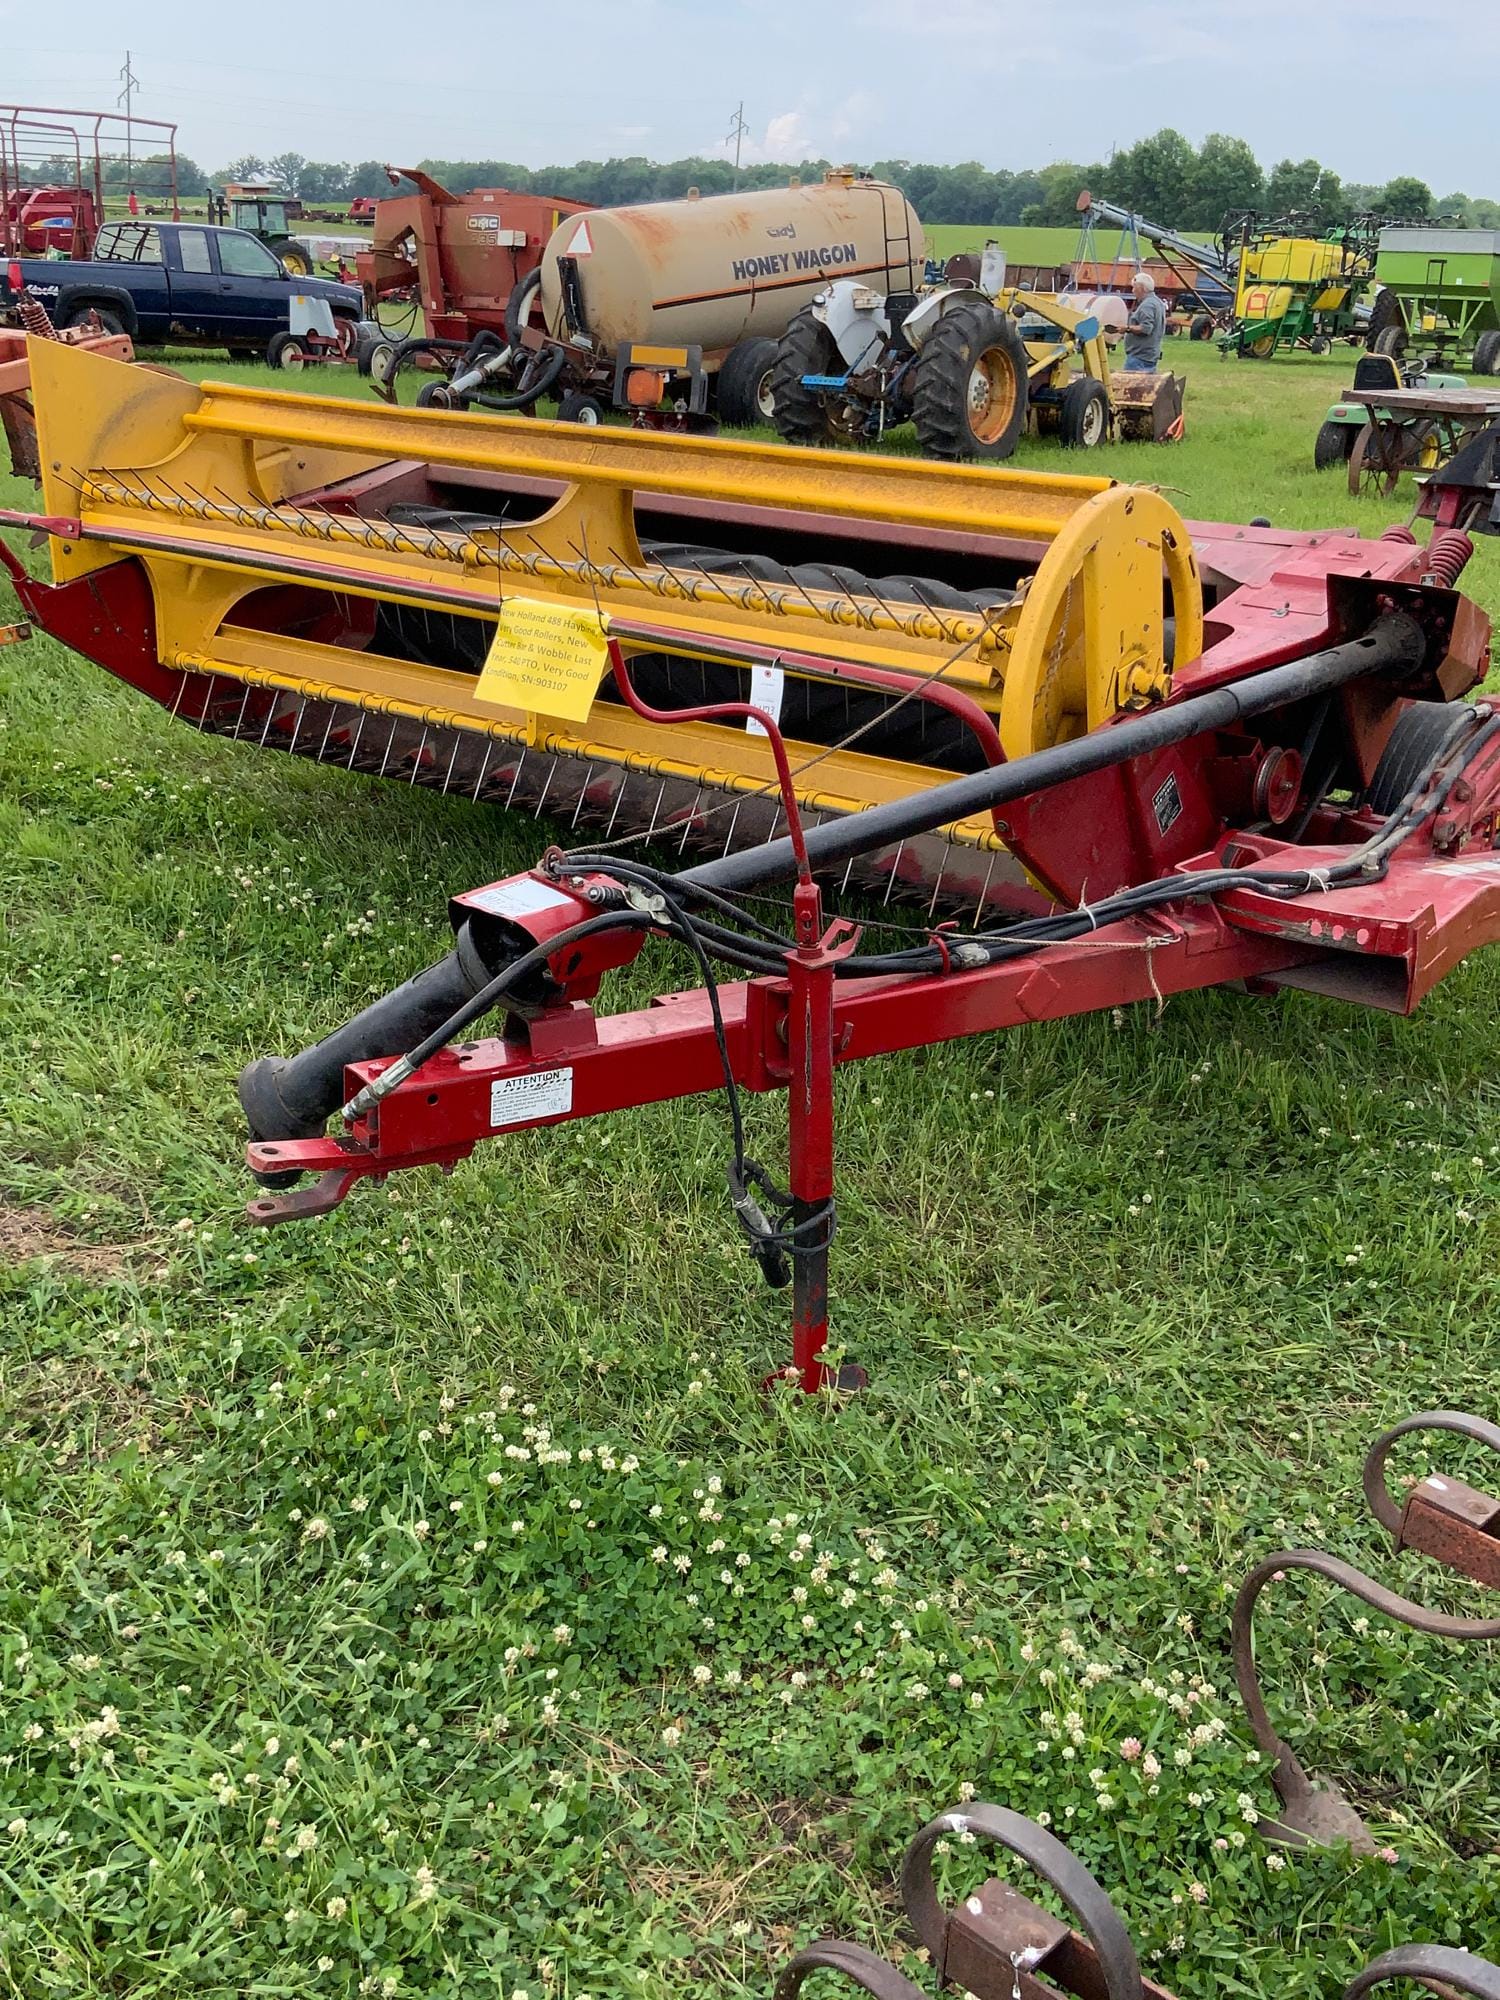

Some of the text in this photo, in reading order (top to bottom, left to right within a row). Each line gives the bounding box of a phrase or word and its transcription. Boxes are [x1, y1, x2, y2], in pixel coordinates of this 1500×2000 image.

[733, 244, 857, 280] HONEY WAGON
[499, 623, 588, 649] Very Good Rollers, New
[518, 611, 545, 623] Holland
[547, 617, 562, 627] 488
[563, 618, 598, 638] Haybine,
[496, 639, 592, 666] Cutter Bar & Wobble Last
[486, 666, 567, 691] Condition, SN:903107
[491, 652, 506, 664] Year,
[543, 663, 564, 676] Very
[565, 668, 590, 681] Good
[505, 1071, 560, 1088] ATTENTION
